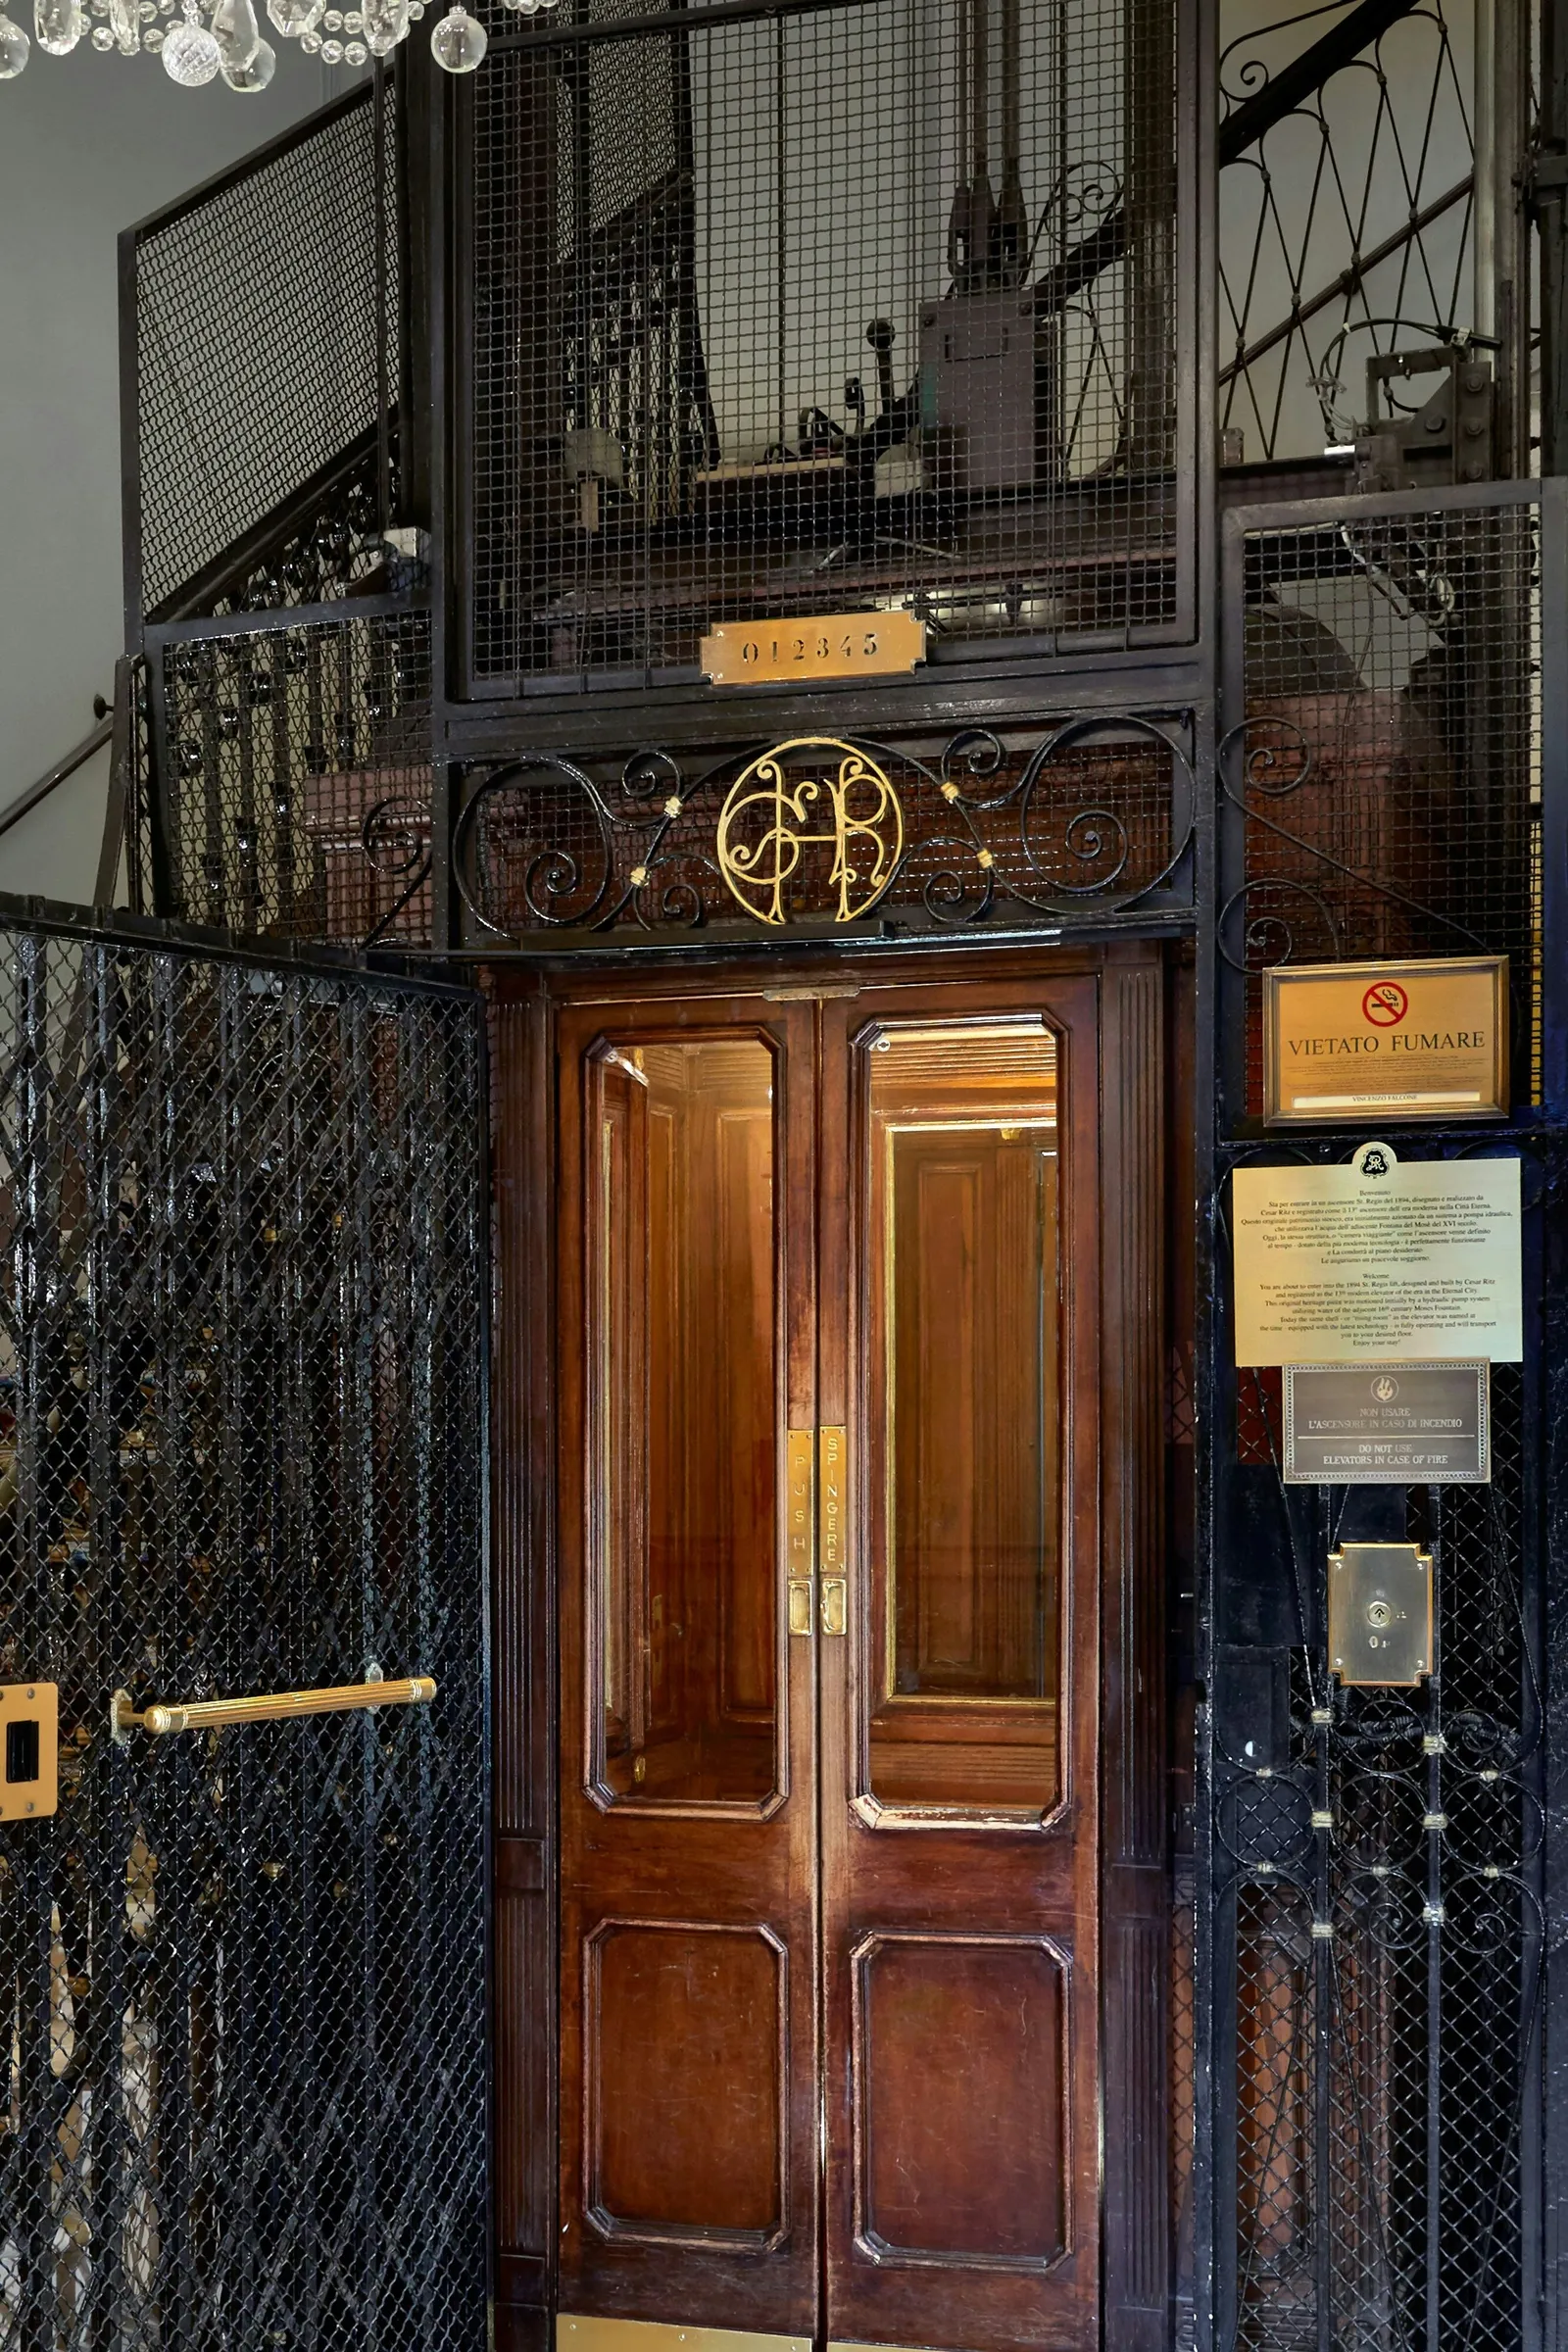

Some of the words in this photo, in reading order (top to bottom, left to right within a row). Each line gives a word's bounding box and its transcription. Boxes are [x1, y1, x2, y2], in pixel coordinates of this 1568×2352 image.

[1289, 1036, 1380, 1055] VIETATO
[1391, 1031, 1486, 1052] FUMARE
[1359, 1407, 1379, 1417] NON
[1381, 1407, 1411, 1417] USARE
[1369, 1419, 1380, 1428] IN
[1381, 1419, 1405, 1429] CASO
[1407, 1419, 1417, 1428] DI
[1419, 1418, 1462, 1428] INCENDIO
[1358, 1445, 1371, 1453] DO
[1374, 1445, 1393, 1453] NOT
[1395, 1444, 1412, 1453] USE
[1323, 1455, 1372, 1465] ELEVATORS
[1375, 1455, 1385, 1464] IN
[1388, 1455, 1410, 1464] CASE
[1412, 1454, 1424, 1464] OF
[1427, 1454, 1448, 1464] FIRE
[793, 1455, 807, 1549] PUSH
[826, 1438, 839, 1562] SPINGERE
